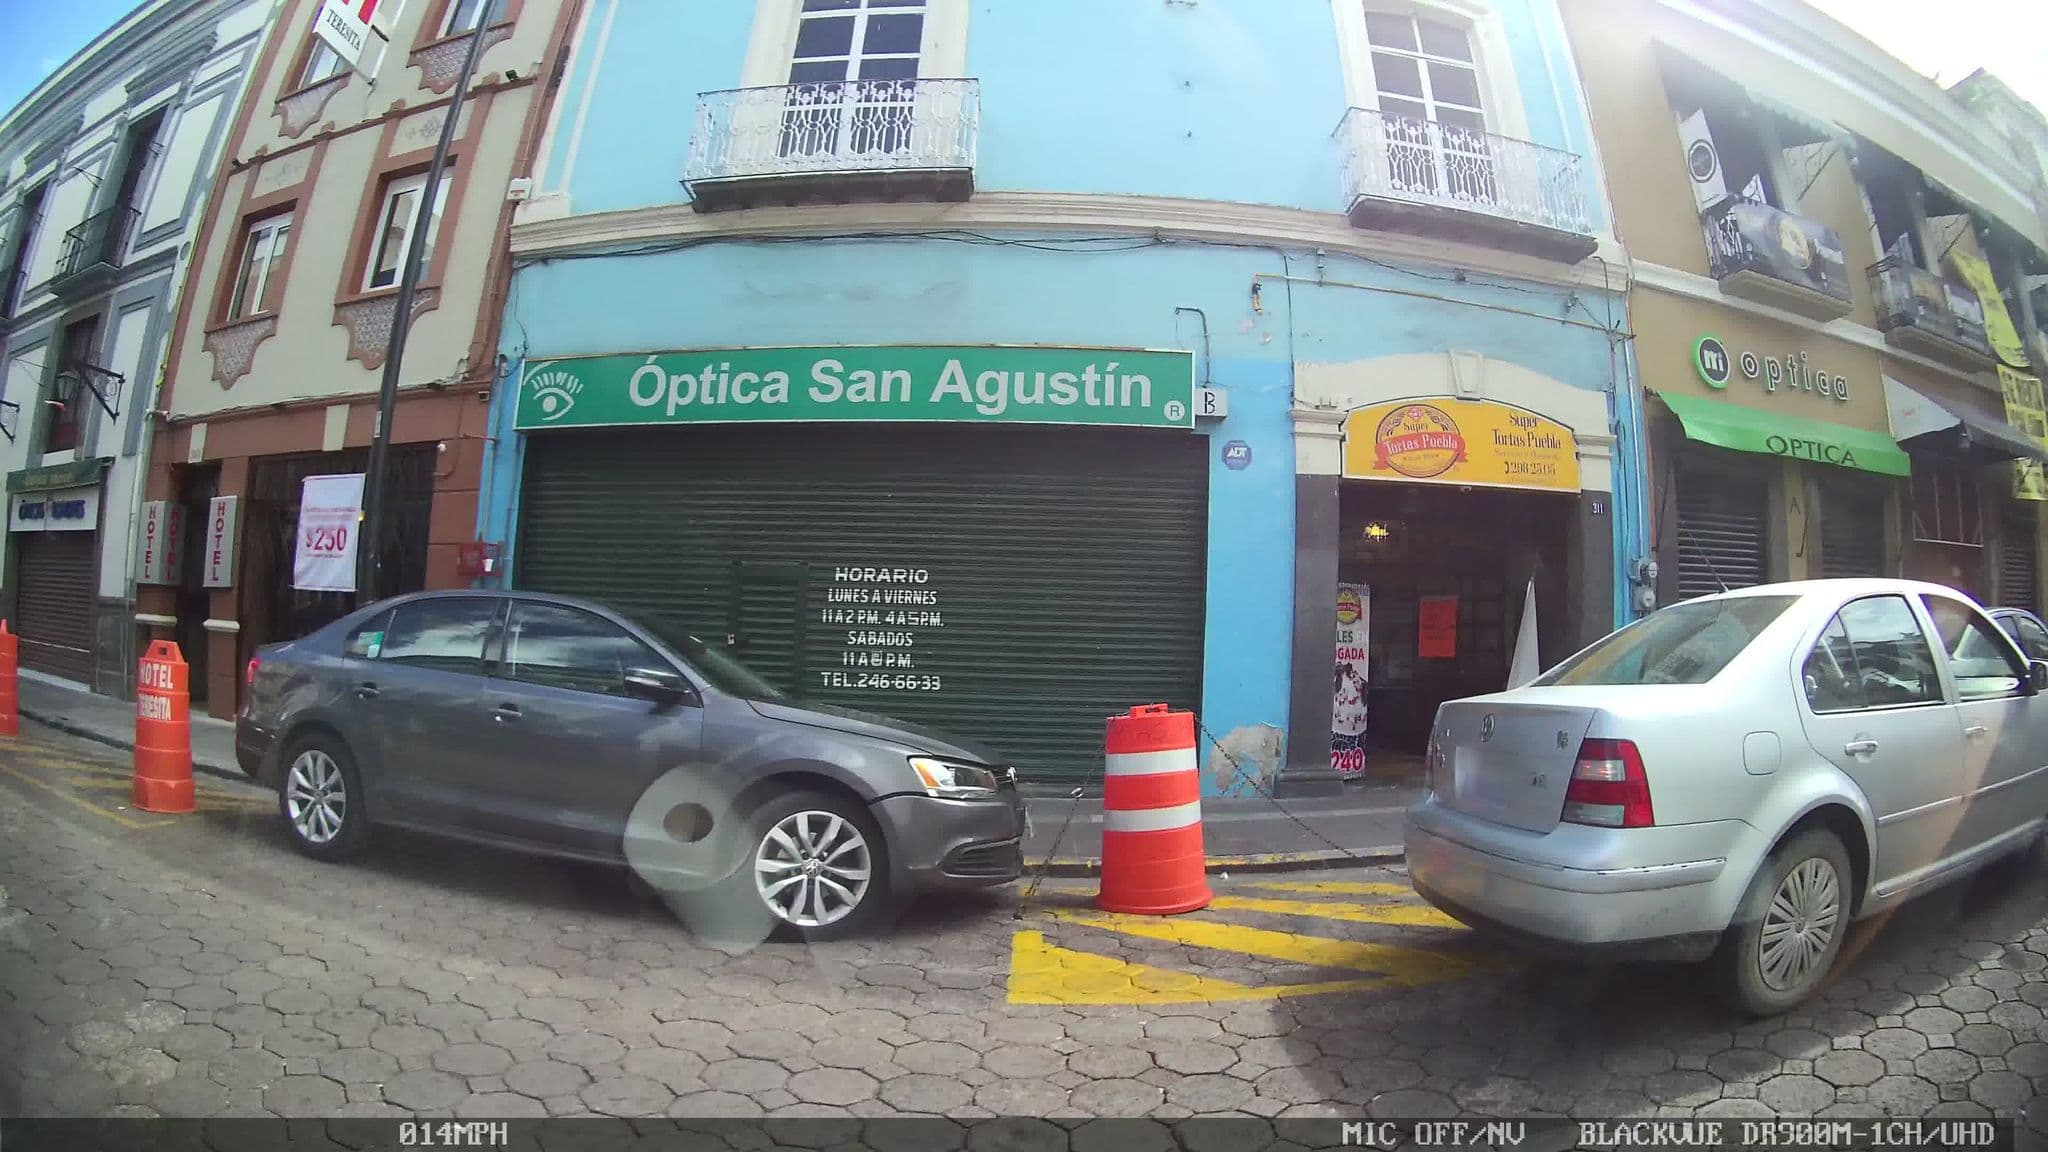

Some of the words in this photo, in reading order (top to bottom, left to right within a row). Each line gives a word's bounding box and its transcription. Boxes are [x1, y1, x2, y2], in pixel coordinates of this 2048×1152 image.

[326, 8, 361, 51] TERESITA
[629, 355, 789, 416] Óptica
[808, 359, 912, 403] San
[929, 359, 1152, 415] Agustín
[1740, 350, 1849, 401] optica
[1204, 391, 1216, 414] B
[1403, 421, 1430, 433] Super
[1509, 412, 1538, 431] Super
[1384, 438, 1420, 456] Tortas
[1422, 433, 1458, 450] Puebla
[1492, 428, 1526, 447] Tortas
[1527, 431, 1562, 449] Puebla
[1226, 447, 1248, 458] ADT
[1766, 435, 1857, 466] OPTICA
[1592, 503, 1605, 514] 311
[144, 506, 156, 579] HOTEL
[212, 502, 226, 581] HOTEL
[305, 526, 347, 551] $250
[835, 567, 929, 583] HORARIO
[828, 588, 869, 603] LUNES
[872, 589, 881, 603] A
[884, 589, 938, 604] VIERNES
[847, 631, 914, 647] SABADOS
[1336, 648, 1365, 660] GADA
[140, 661, 174, 689] HOTEL
[138, 693, 171, 721] TERESITA
